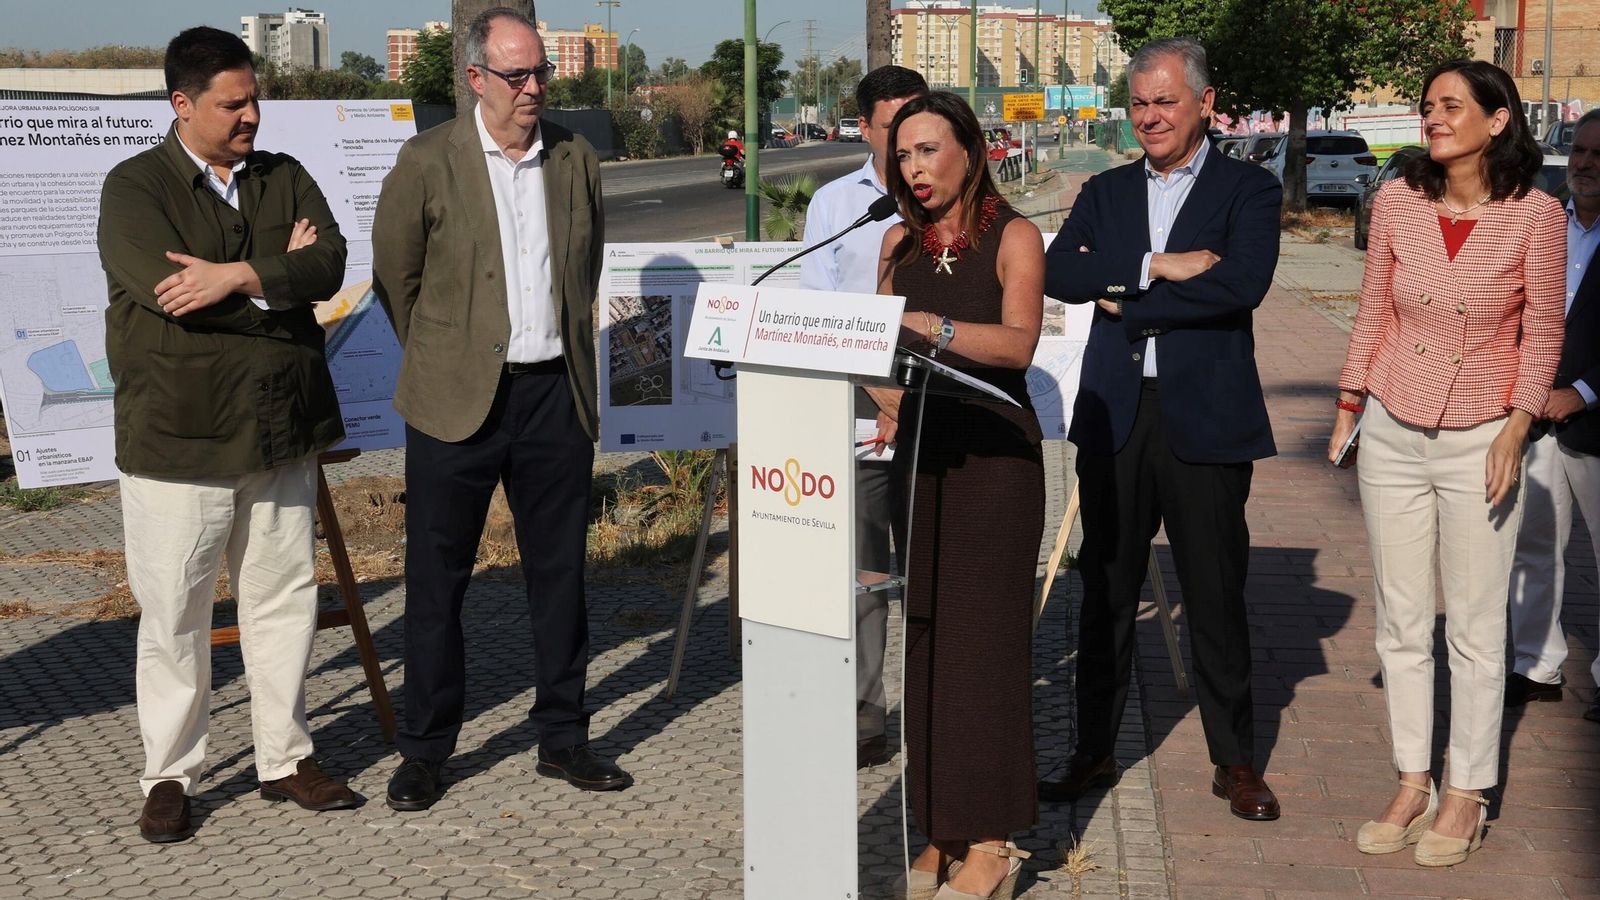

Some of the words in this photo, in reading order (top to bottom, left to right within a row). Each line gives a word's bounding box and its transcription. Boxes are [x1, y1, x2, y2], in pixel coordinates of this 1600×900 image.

[26, 119, 54, 132] que
[58, 116, 88, 128] mira
[92, 116, 103, 128] al
[106, 115, 153, 128] futuro:
[28, 132, 100, 146] Montañés
[104, 136, 120, 146] en
[26, 172, 62, 180] responden
[758, 309, 771, 324] Un
[773, 310, 800, 326] barrio
[802, 316, 819, 329] que
[821, 314, 843, 329] mira
[845, 317, 854, 331] al
[856, 317, 886, 334] futuro
[755, 327, 792, 343] Martínez
[794, 330, 839, 349] Montañés,
[841, 338, 853, 348] en
[854, 338, 889, 352] marcha
[16, 450, 31, 462] 01
[802, 518, 810, 526] DE
